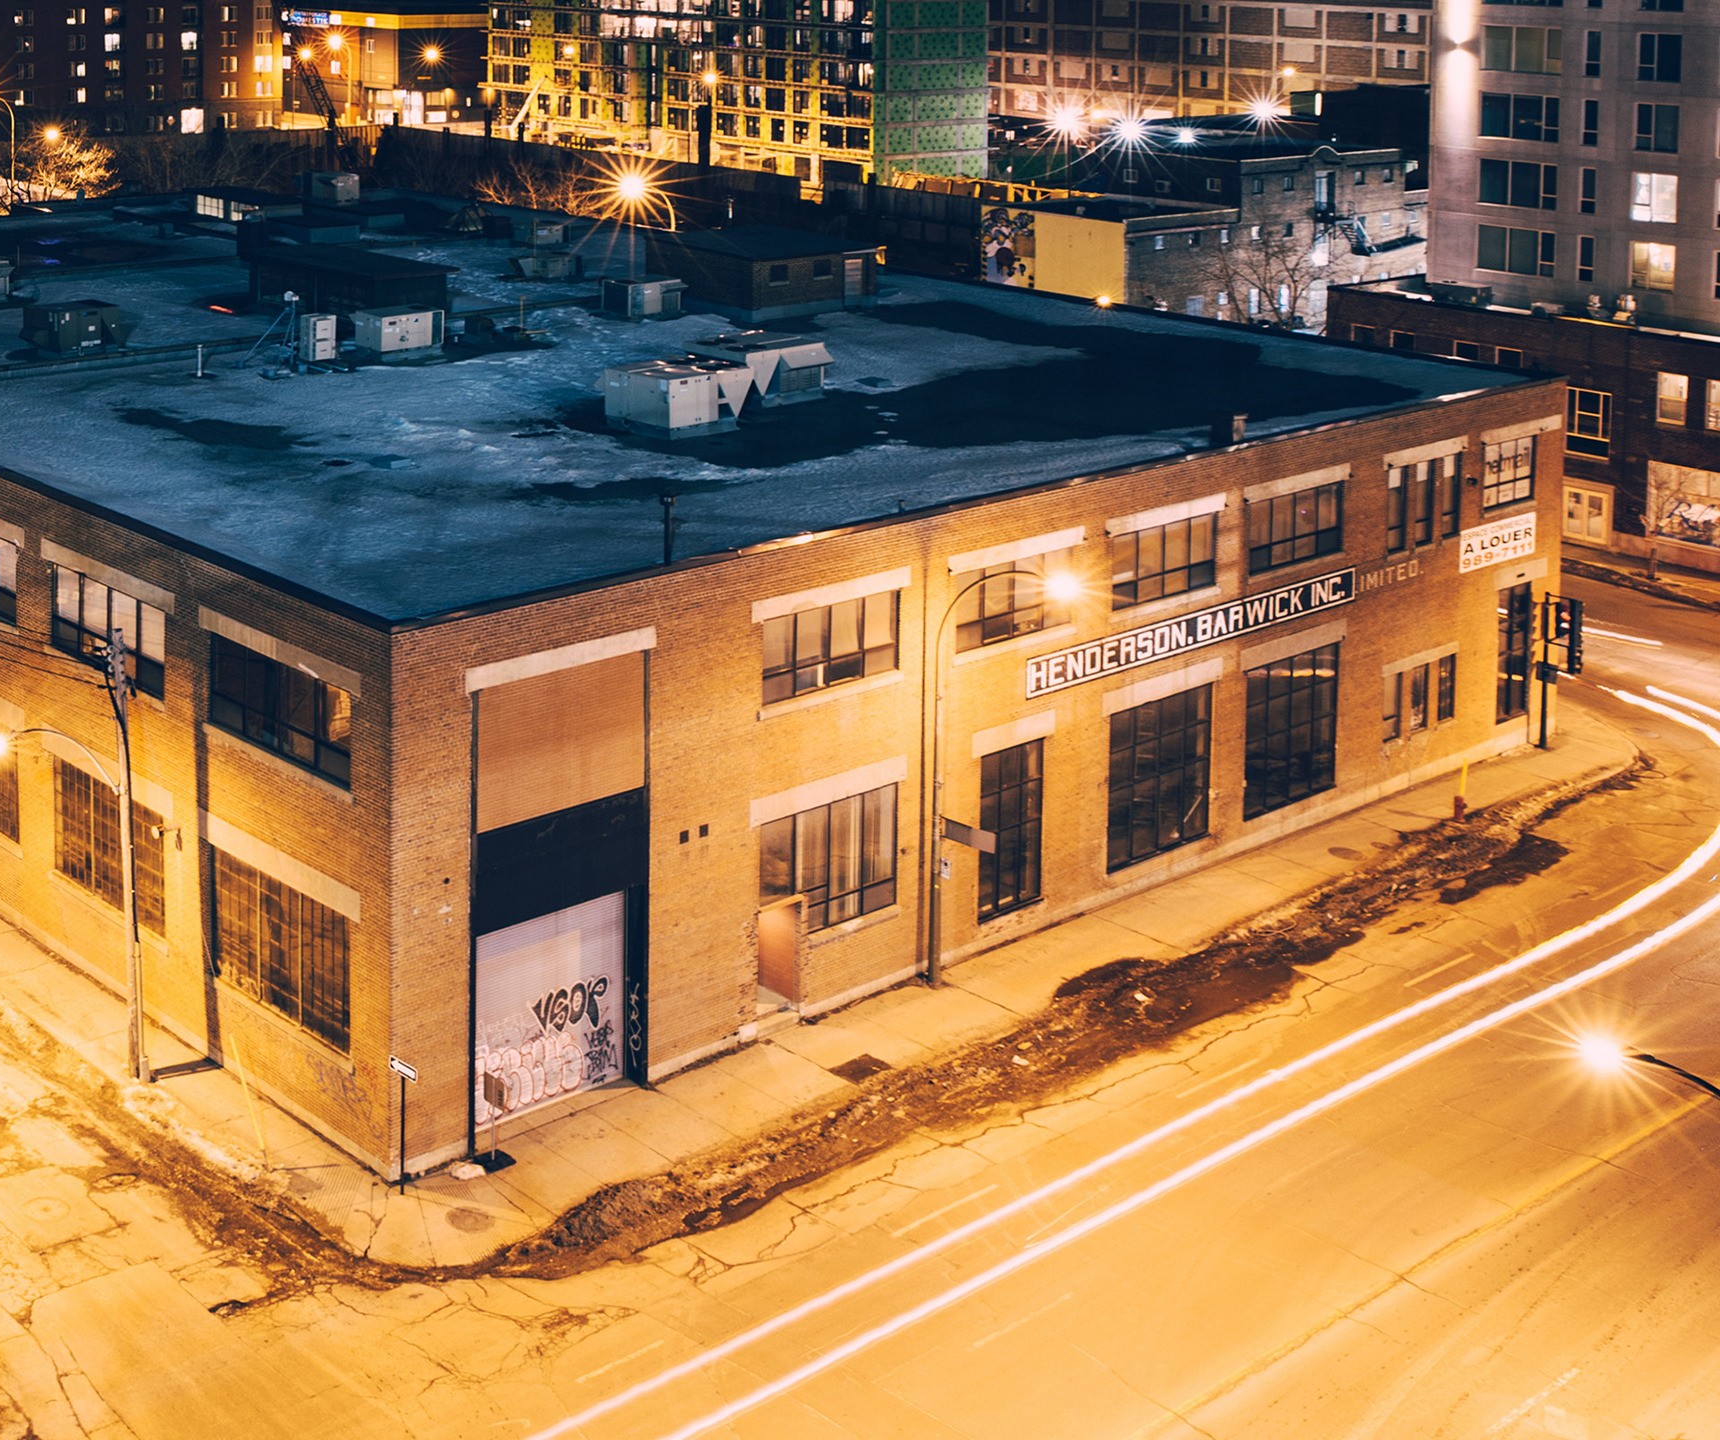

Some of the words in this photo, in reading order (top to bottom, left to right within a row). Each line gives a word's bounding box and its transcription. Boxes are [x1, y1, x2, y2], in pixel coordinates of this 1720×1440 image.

[1464, 543, 1474, 555] A
[1480, 527, 1532, 550] LOUER
[1356, 560, 1424, 593] IMITED.
[1197, 588, 1303, 641] BARWICK
[1311, 576, 1345, 607] INC.
